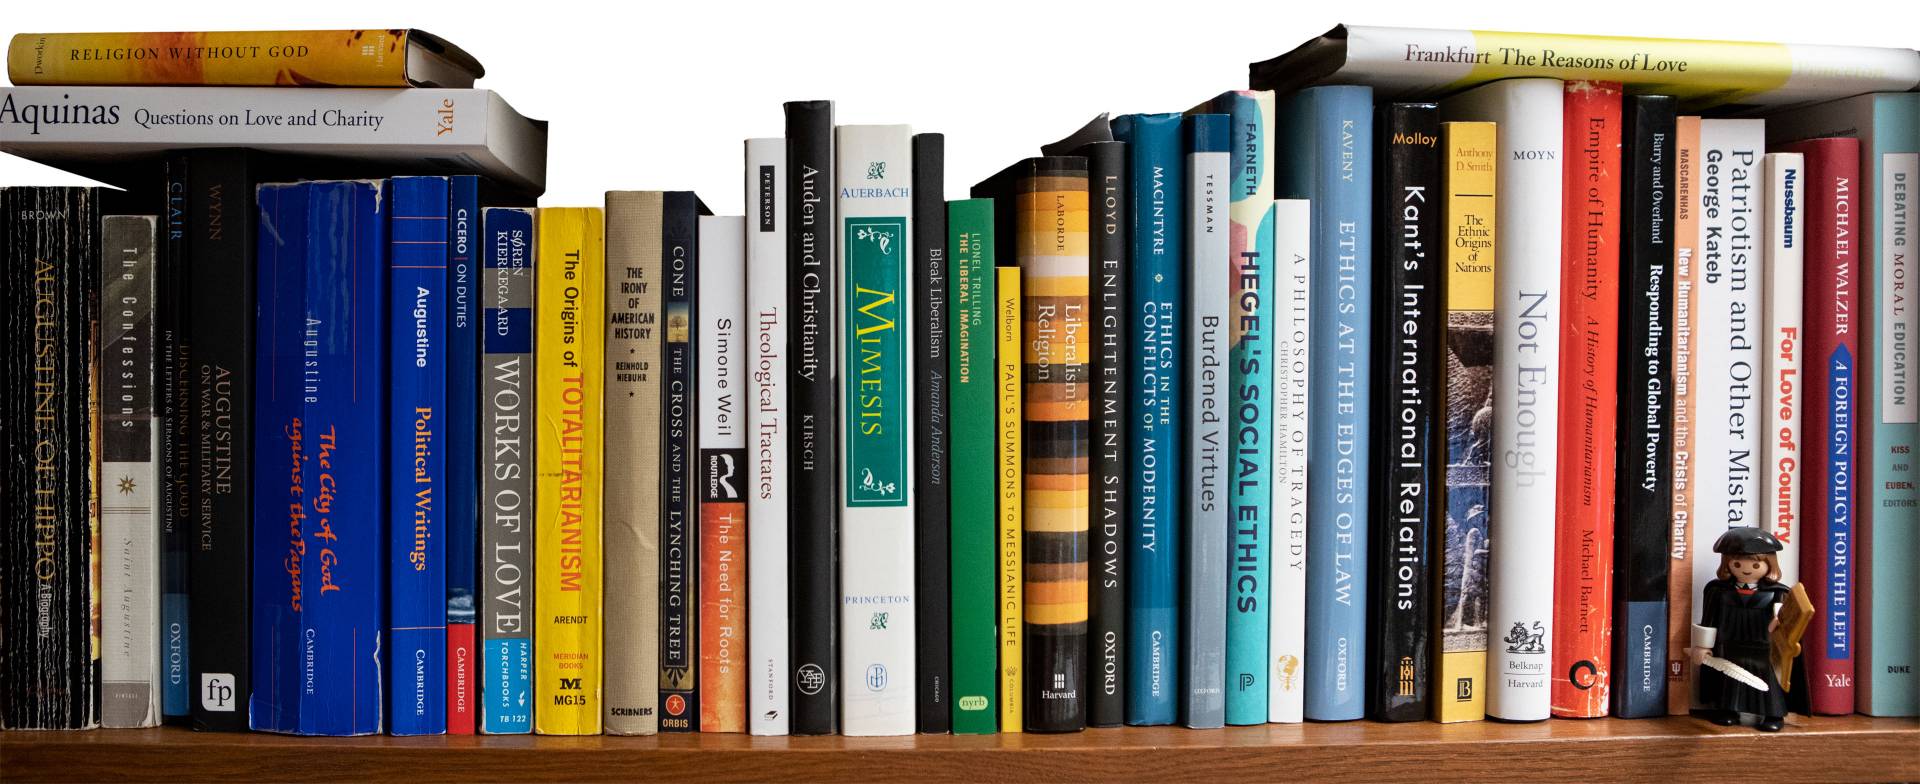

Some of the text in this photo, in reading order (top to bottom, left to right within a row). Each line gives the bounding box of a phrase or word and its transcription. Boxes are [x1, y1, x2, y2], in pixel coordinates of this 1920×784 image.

[36, 37, 46, 75] Dworkin
[71, 44, 309, 60] RELIGION WITHOUT GOD
[1405, 44, 1687, 72] Frankfurt The Reasons of Love
[0, 93, 384, 135] Aquinas Questions on Love and Charity
[438, 98, 454, 136] Yale
[1392, 132, 1438, 148] Molloy
[1245, 124, 1258, 196] FARNETH
[1342, 119, 1354, 182] KAVENY
[1513, 150, 1556, 161] MOYN
[169, 182, 183, 241] CLAIR
[209, 184, 222, 241] WYNN
[764, 172, 772, 226] PETERSON
[840, 187, 910, 199] AUERBACH
[1104, 176, 1118, 235] LLOYD
[1153, 166, 1165, 255] MACINTYRE
[1206, 174, 1214, 233] TESSMAN
[1583, 118, 1605, 301] Empire of Humanity
[1679, 149, 1690, 220] MASCARENHAS
[1783, 169, 1797, 248] Nussbaum
[21, 209, 67, 221] BROWN
[1056, 195, 1066, 251] LABORDE
[1456, 237, 1492, 249] Origins
[1458, 225, 1491, 236] Ethnic
[1465, 214, 1484, 224] The
[1703, 150, 1722, 284] George Kateb
[456, 208, 467, 328] CICERO ON DUTIES
[513, 230, 524, 276] SØREN
[626, 268, 644, 278] THE
[672, 245, 685, 297] CONE
[798, 164, 821, 383] Auden and Christianity
[1456, 262, 1492, 273] Nations
[1468, 254, 1478, 262] of
[1835, 176, 1849, 336] MICHAEL WALZER
[497, 231, 509, 337] KIERKEGAARD
[621, 283, 648, 294] IRONY
[628, 298, 641, 308] OF
[960, 233, 970, 384] THE LIBERAL IMAGINATION
[1893, 172, 1907, 406] DEBATING MORAL EDUCATION
[35, 257, 56, 430] AUGUSTINE
[121, 247, 138, 428] The Confessions
[414, 286, 430, 367] Augustine
[611, 313, 655, 323] AMERICAN
[614, 328, 651, 339] HISTORY
[1005, 298, 1016, 342] Welborn
[1033, 304, 1056, 381] Religion
[1728, 149, 1754, 528] Patriotism and Other Mista
[304, 318, 322, 404] Augustine
[616, 362, 649, 370] REINHOLD
[717, 318, 732, 436] Simone Weil
[855, 283, 896, 436] MIMESIS
[1064, 303, 1082, 410] Liberalism's
[1642, 264, 1664, 492] Responding to Global Poverty
[755, 307, 778, 500] Theological Tractates
[1201, 315, 1219, 512] Burdened Virtues
[1291, 253, 1306, 571] A PHILOSOPHY OF TRAGEDY
[1337, 221, 1356, 606] ETHICS AT THE EDGES OF LAW
[1398, 186, 1425, 610] Kant's International Relations
[1505, 290, 1549, 488] Not Enough
[215, 365, 232, 495] AUGUSTINE
[560, 250, 584, 593] The Origins of TOTALITARIANISM
[803, 414, 814, 471] KIRSCH
[1103, 259, 1119, 589] ENLIGHTENMENT SHADOWS
[1238, 252, 1260, 613] HEGEL'S SOCIAL ETHICS
[1774, 327, 1797, 543] For Love of Country
[1891, 446, 1910, 454] KISS
[35, 440, 56, 478] OF
[410, 406, 432, 571] Political Writings
[709, 455, 719, 499] ROUTLEDGE
[494, 356, 522, 635] WORKS OF LOVE
[553, 616, 588, 624] ARENDT
[845, 596, 910, 604] PRINCETON
[306, 628, 316, 695] CAMBRIDGE
[416, 649, 426, 716] CAMBRIDGE
[457, 647, 467, 713] CAMBRIDGE
[501, 641, 510, 708] TORCHBOOKS
[520, 642, 528, 681] HARPER
[1104, 631, 1116, 696] OXFORD
[1152, 630, 1162, 697] CAMBRIDGE
[1337, 637, 1348, 691] OXFORD
[1507, 680, 1544, 690] Harvard
[1508, 660, 1544, 673] Belknap
[1643, 624, 1654, 692] CAMBRIDGE
[1824, 674, 1852, 688] Yale
[1888, 666, 1912, 674] DUKE
[500, 715, 527, 723] TB 122
[553, 695, 586, 706] MG15
[611, 707, 653, 716] SCRIBNERS
[663, 718, 689, 728] ORBIS
[961, 698, 985, 707] nyrb
[1042, 690, 1077, 699] Harvard
